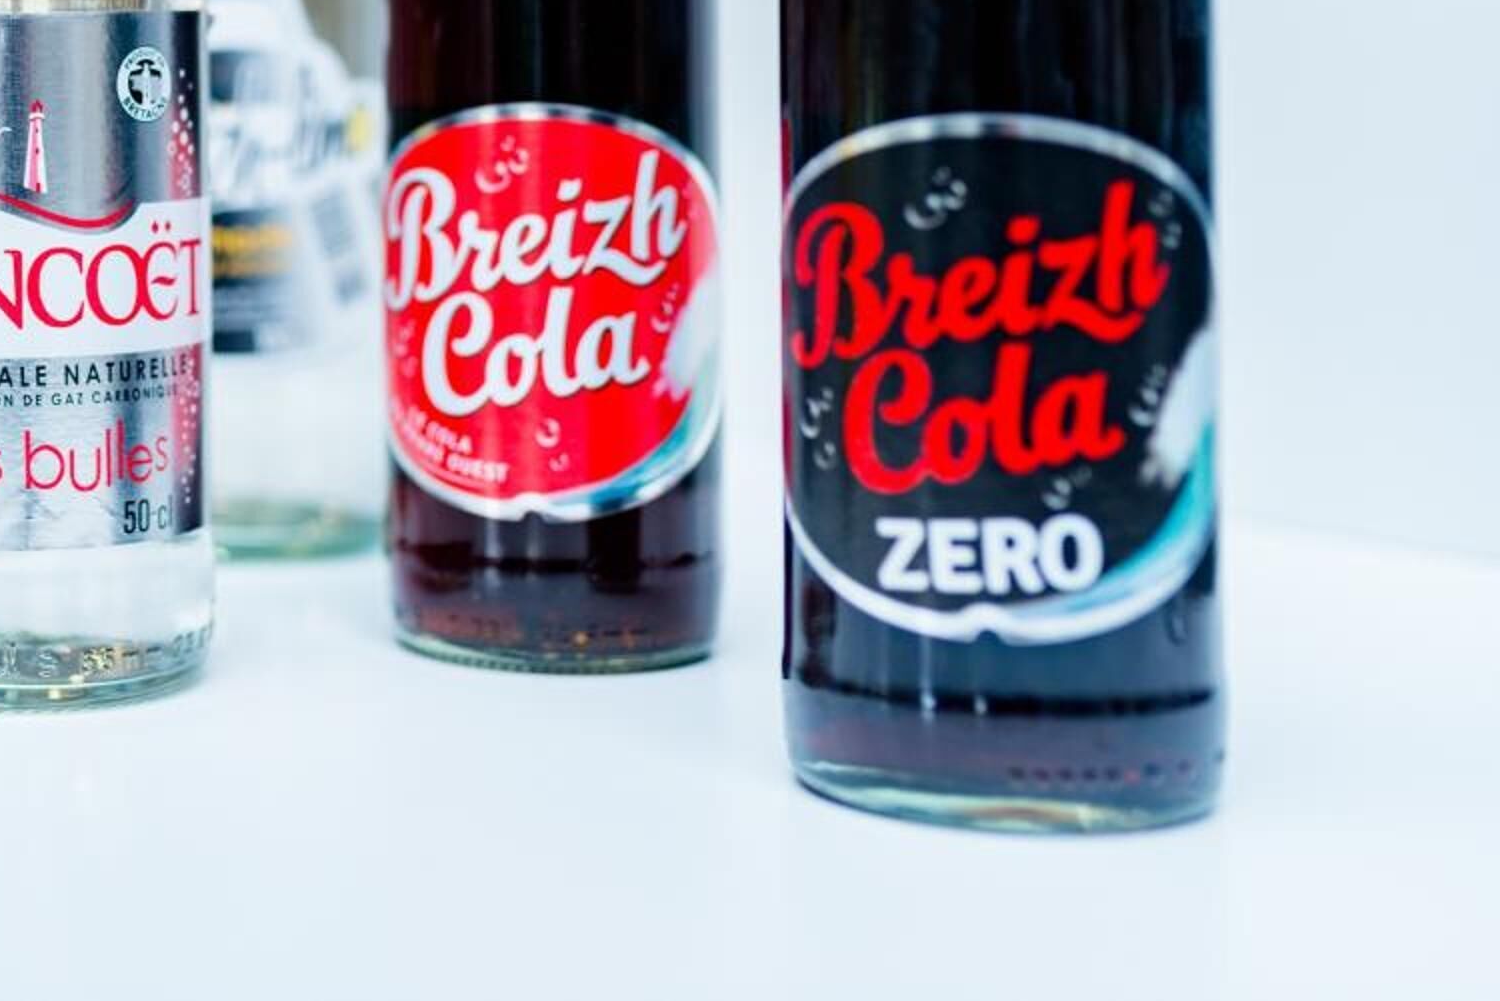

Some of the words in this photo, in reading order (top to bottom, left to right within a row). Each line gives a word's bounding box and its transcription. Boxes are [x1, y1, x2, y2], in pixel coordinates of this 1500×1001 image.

[386, 149, 687, 312] Breizh
[790, 179, 1169, 369] Breizh
[64, 353, 187, 386] NATURELLE
[422, 286, 650, 418] Cola
[23, 393, 43, 407] DE
[51, 392, 83, 406] GAZ
[842, 342, 1126, 495] Cola
[22, 418, 169, 492] bulles
[123, 499, 151, 534] 50
[157, 494, 172, 529] cl
[874, 512, 1104, 595] ZERO
